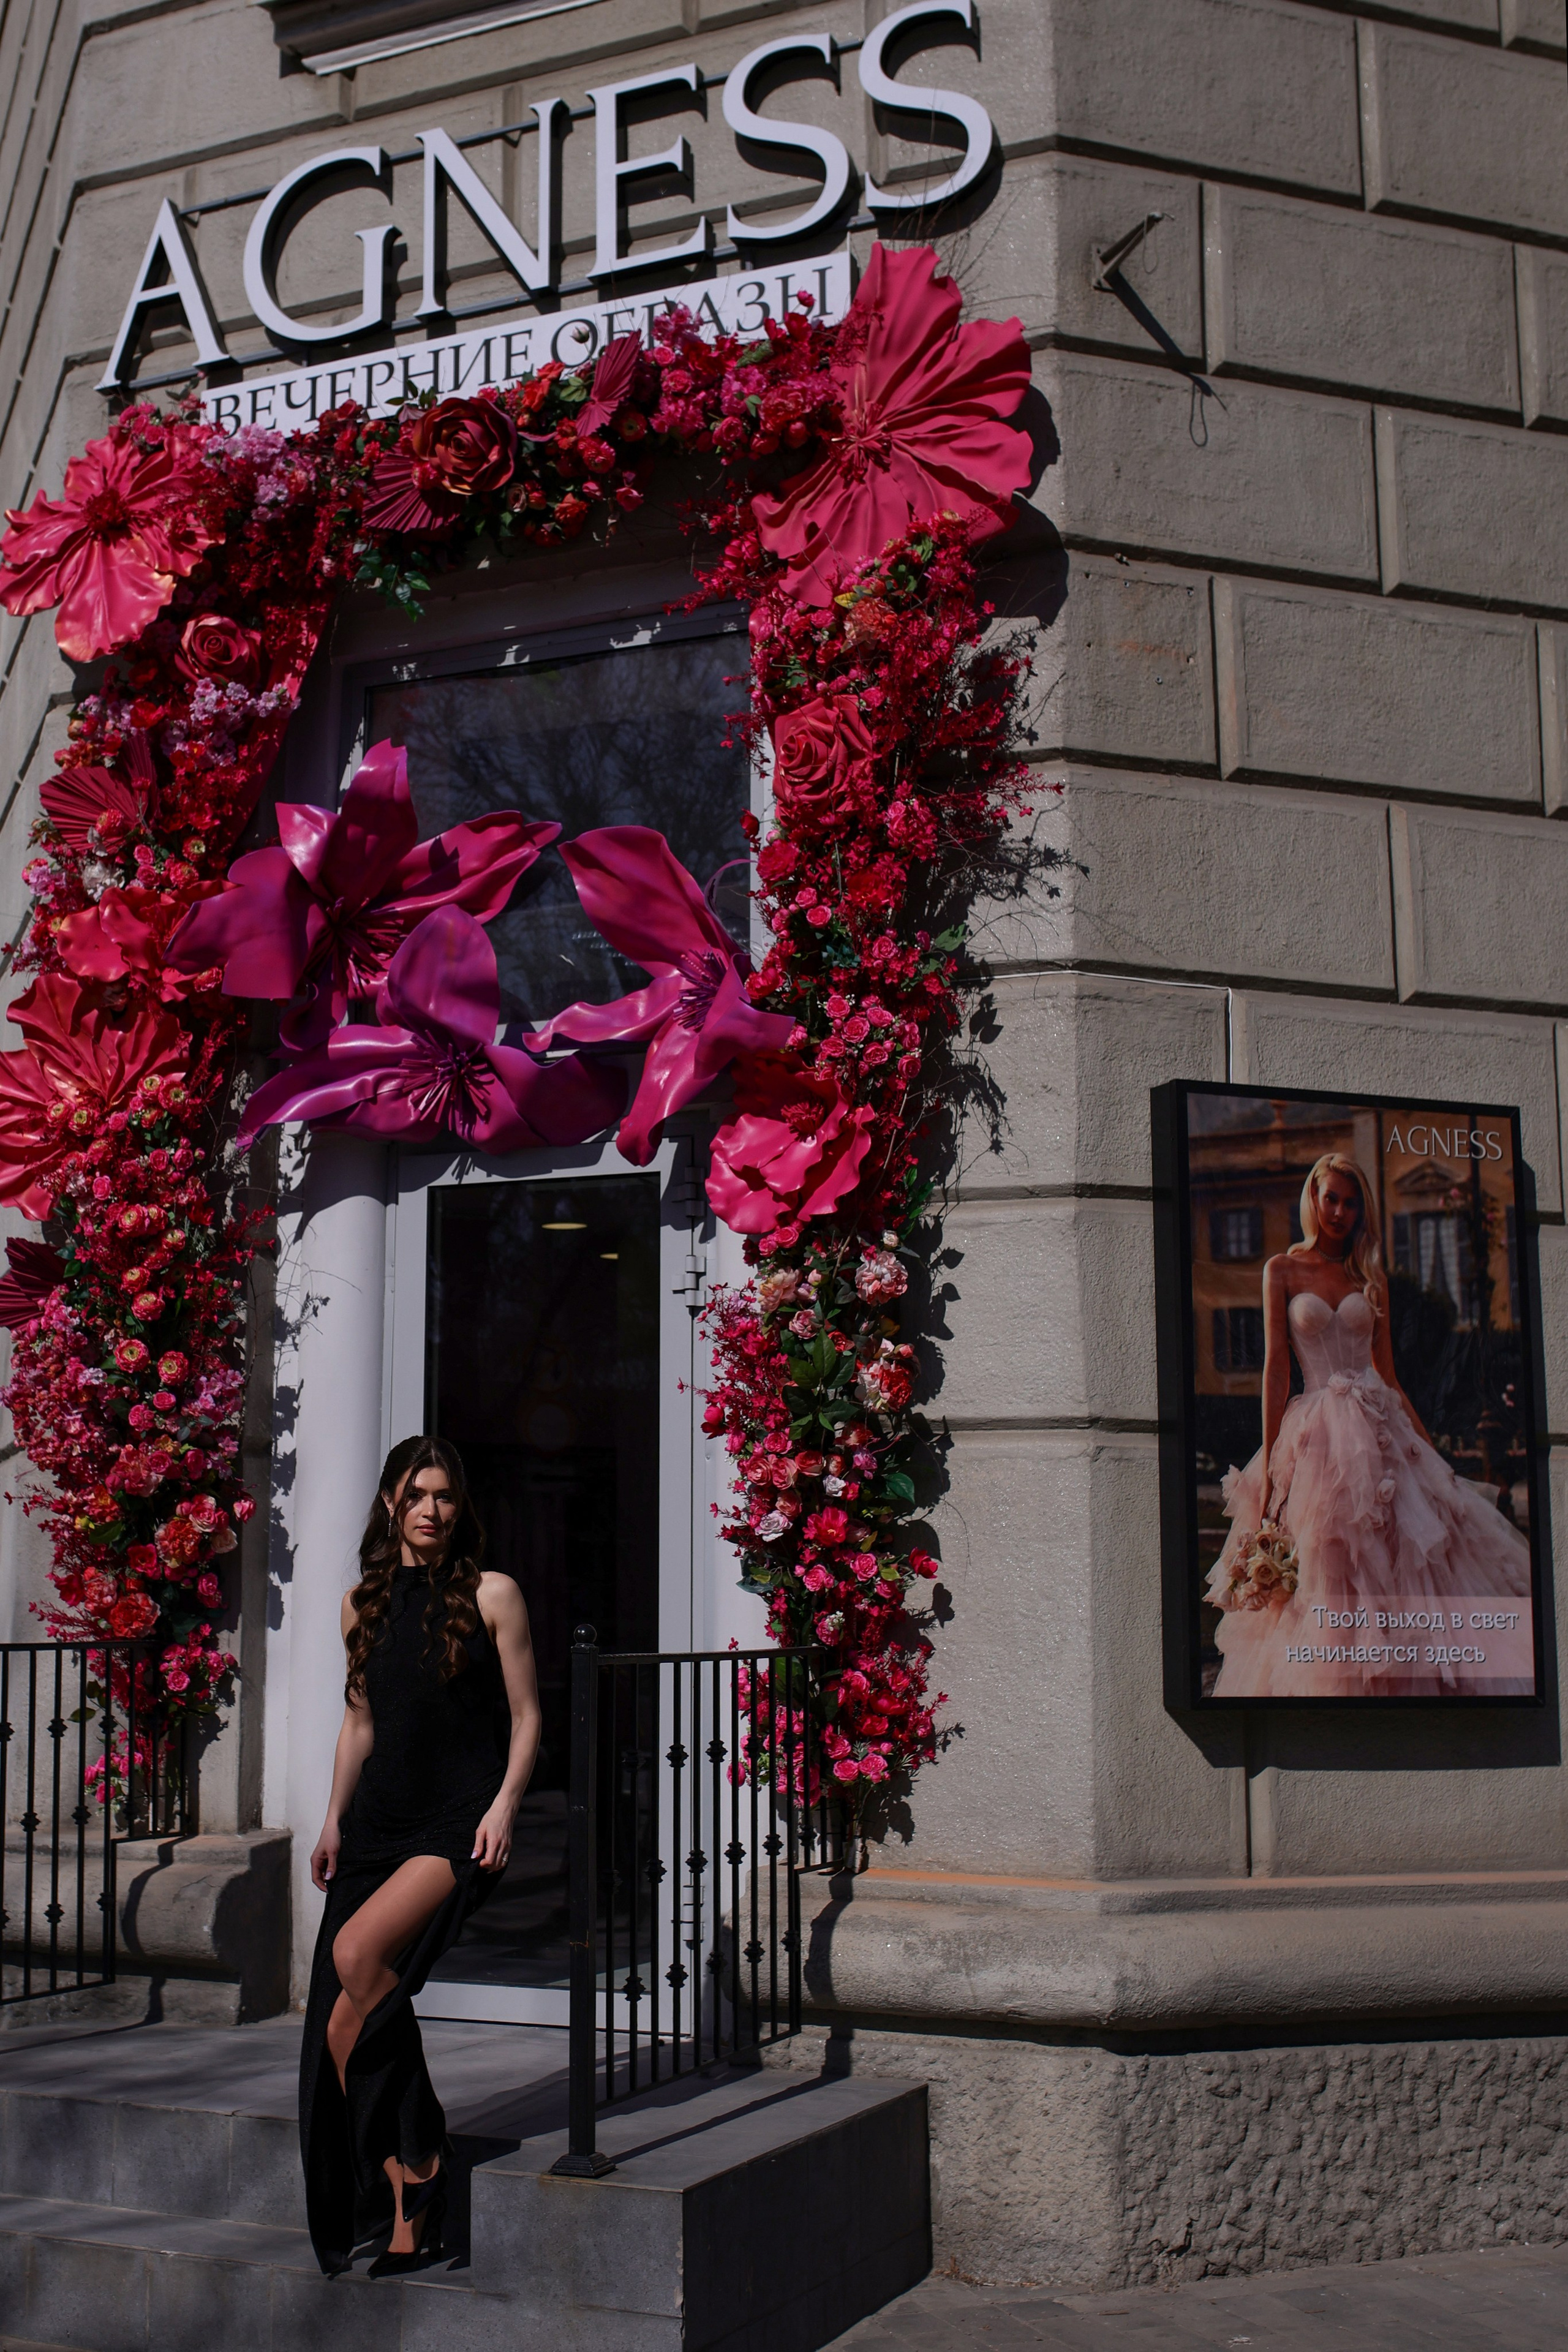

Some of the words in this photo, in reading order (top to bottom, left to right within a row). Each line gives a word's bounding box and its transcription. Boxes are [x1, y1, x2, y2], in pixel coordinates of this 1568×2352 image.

[94, 0, 993, 390] AGNESS
[211, 329, 534, 437] ВЕЧЕРНИЕ
[1387, 1125, 1502, 1160] AGNESS
[1312, 1605, 1369, 1629] Твой
[1375, 1612, 1445, 1632] выход
[1451, 1613, 1463, 1629] в
[1469, 1613, 1519, 1630] свет
[1286, 1645, 1419, 1663] начинается
[1425, 1646, 1486, 1665] здесь
